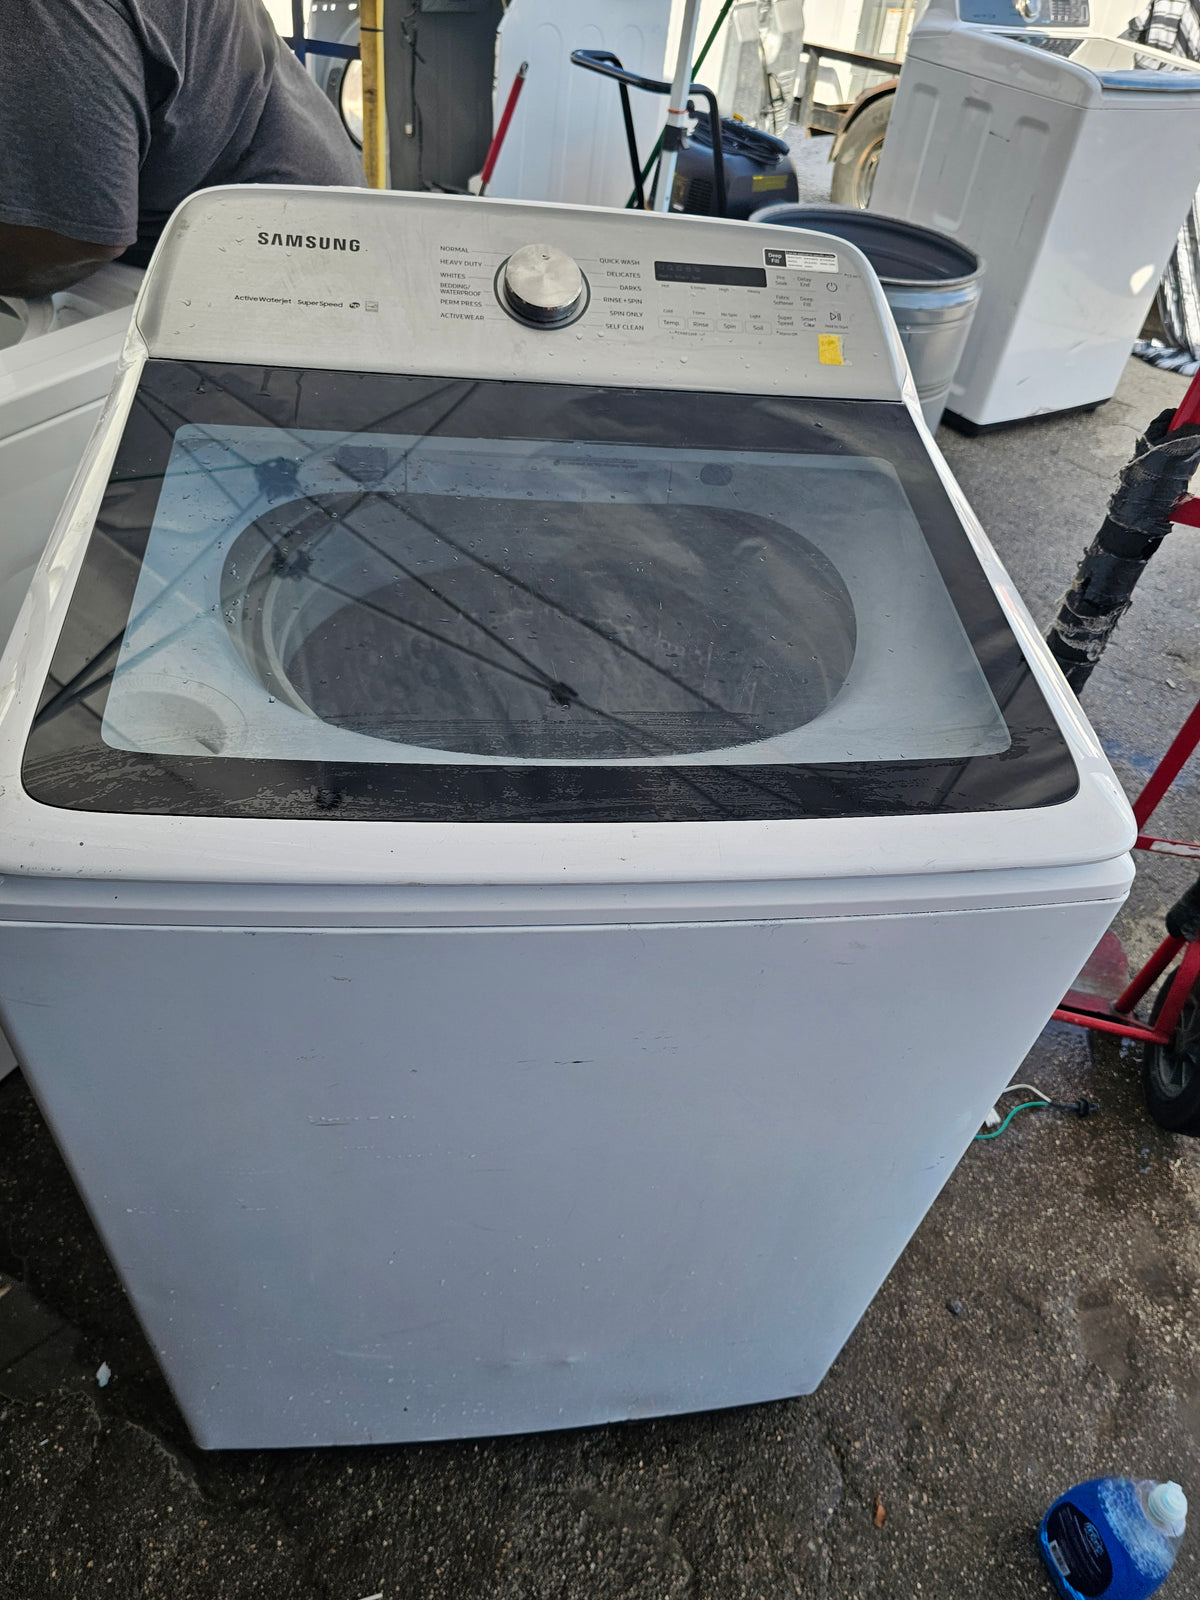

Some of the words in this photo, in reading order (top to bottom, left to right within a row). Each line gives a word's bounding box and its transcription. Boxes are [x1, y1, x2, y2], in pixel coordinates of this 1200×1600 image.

[258, 232, 360, 252] SAMSUNG
[440, 289, 481, 297] WATERPROOF
[440, 313, 485, 321] ACTIVEWEAR
